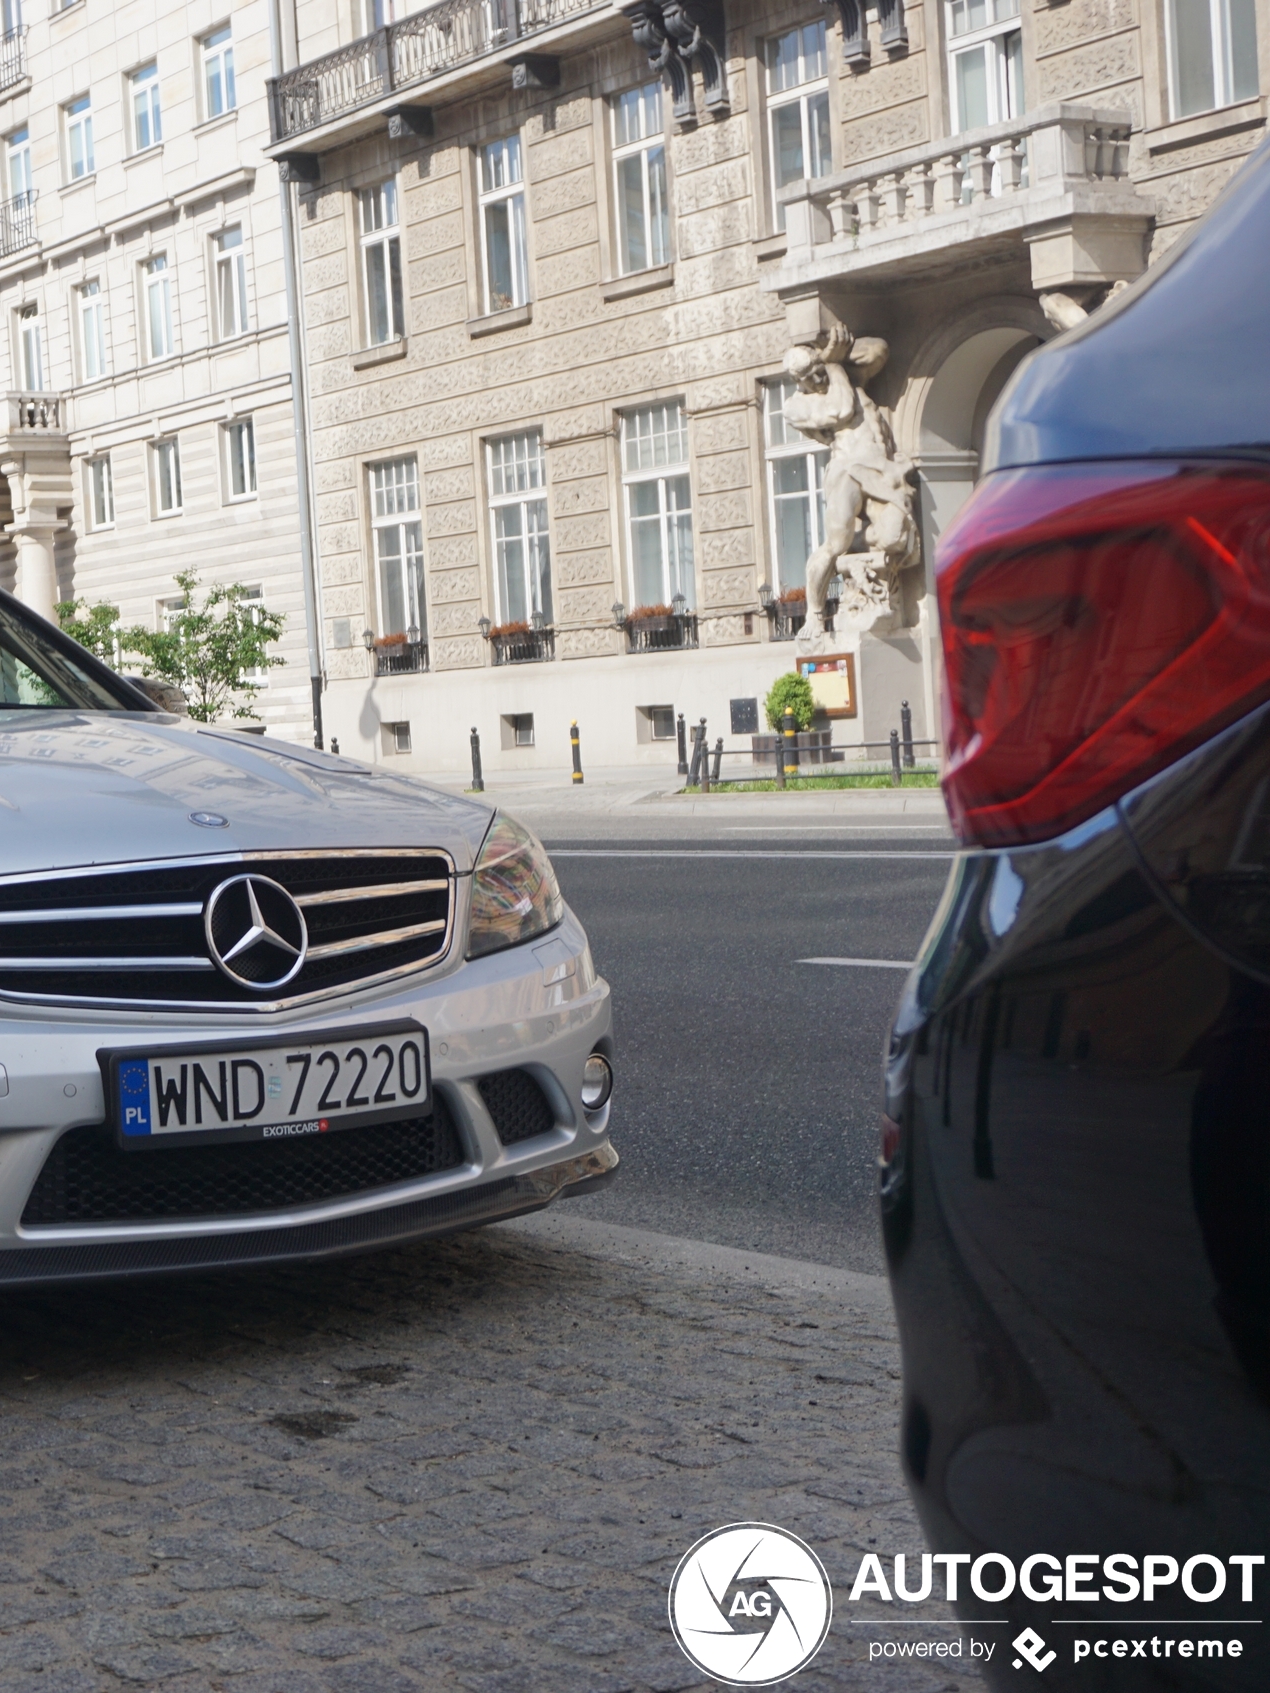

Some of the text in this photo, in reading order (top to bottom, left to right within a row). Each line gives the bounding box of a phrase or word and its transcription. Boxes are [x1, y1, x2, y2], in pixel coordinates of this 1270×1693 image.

[154, 1040, 421, 1127] WND 72220
[125, 1107, 147, 1125] PL
[263, 1121, 320, 1137] EXOTICCARS
